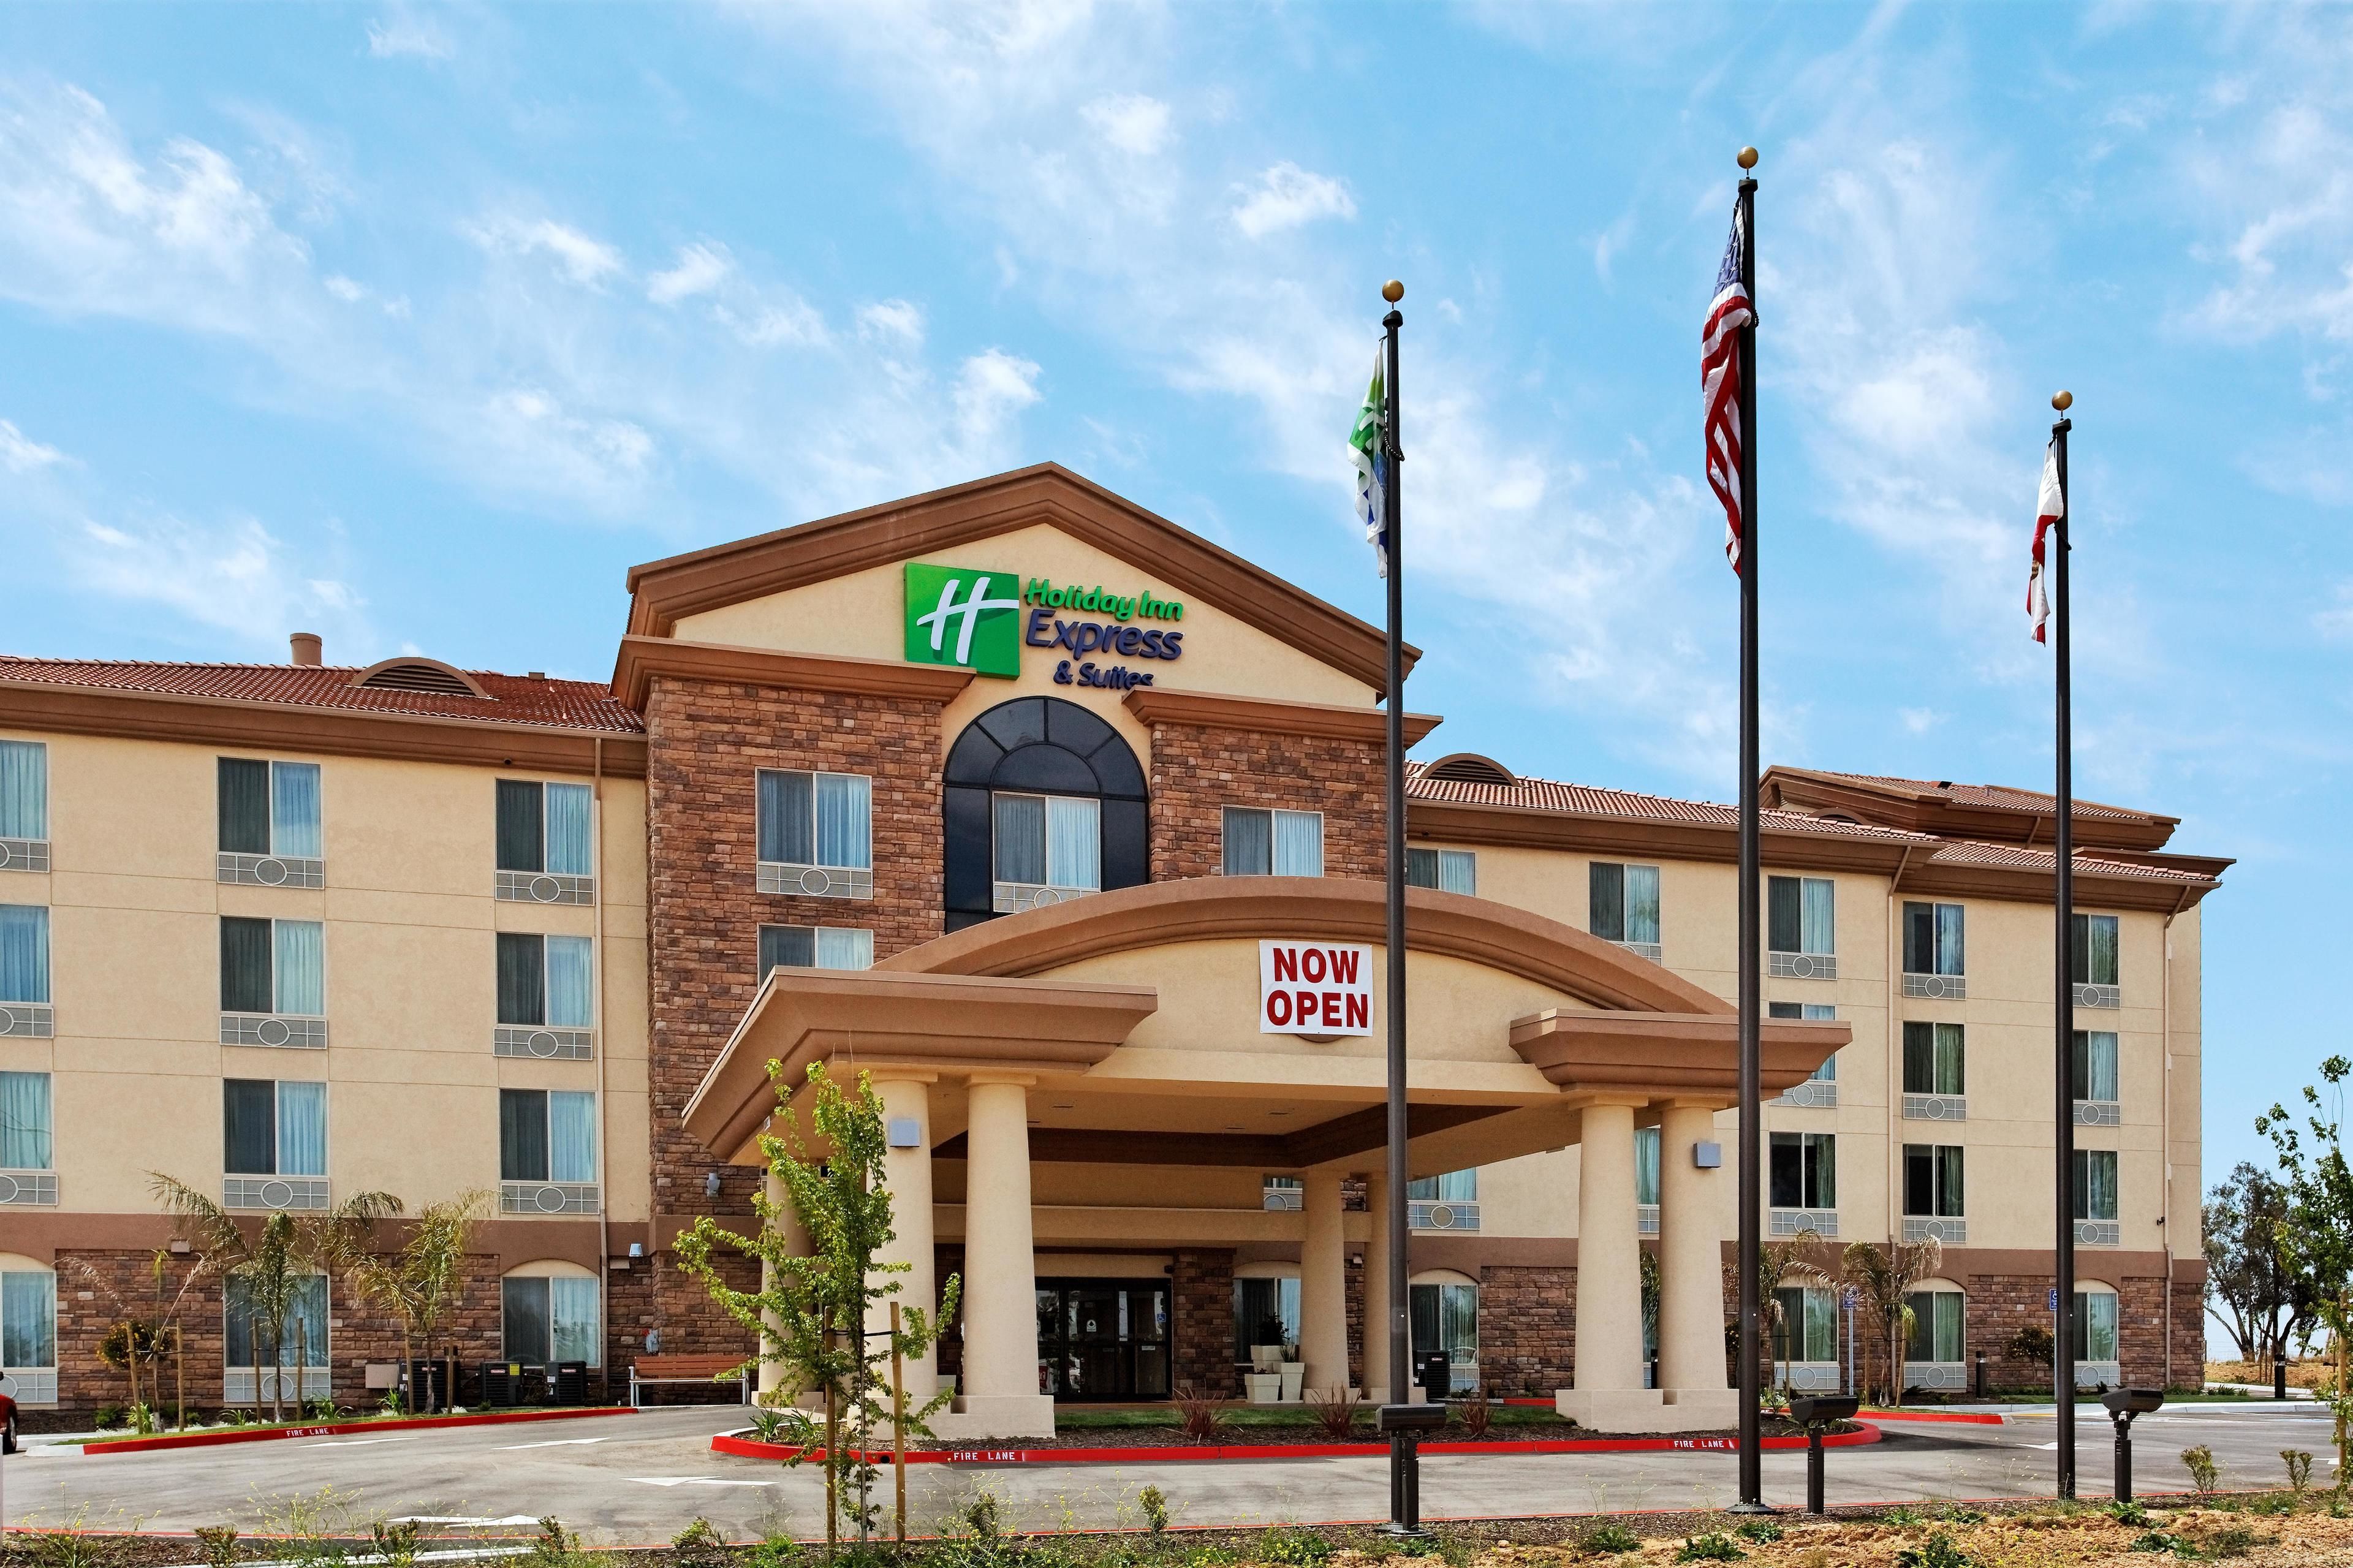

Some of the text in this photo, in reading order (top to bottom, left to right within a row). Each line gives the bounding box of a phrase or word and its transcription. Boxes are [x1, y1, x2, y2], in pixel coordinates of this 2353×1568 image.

[1024, 577, 1184, 622] Holiday Inn
[1025, 608, 1184, 661] Express
[1052, 659, 1154, 691] & Suites
[1273, 947, 1360, 984] NOW
[1267, 990, 1368, 1028] OPEN
[953, 1452, 1015, 1461] FIRE LANE
